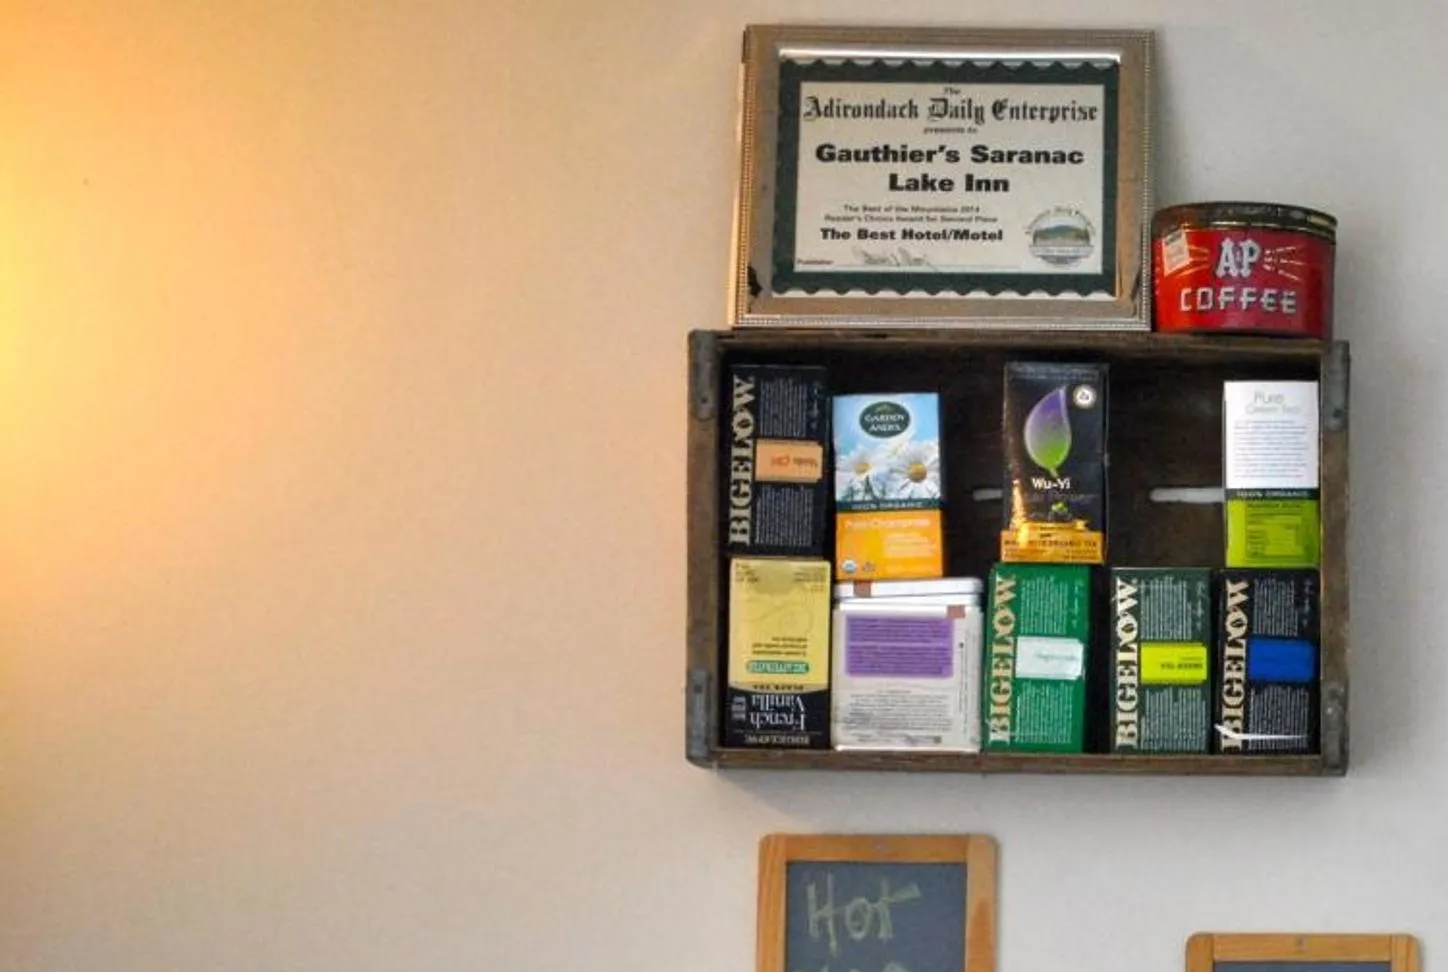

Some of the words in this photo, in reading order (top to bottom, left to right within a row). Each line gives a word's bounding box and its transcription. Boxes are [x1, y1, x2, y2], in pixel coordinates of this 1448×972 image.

[803, 96, 918, 121] Adirondack
[926, 97, 985, 125] Daily
[991, 99, 1098, 124] Enterprise
[815, 144, 960, 164] Gauthier's
[970, 145, 1084, 165] Saranac
[889, 173, 954, 192] Lake
[965, 174, 1010, 192] Inn
[820, 228, 850, 240] The
[857, 229, 895, 241] Best
[900, 229, 1003, 242] Hotel/Motel
[1180, 287, 1297, 315] COFFEE
[729, 374, 756, 546] BIGELOW
[1031, 477, 1072, 490] Wu-Yi
[988, 573, 1017, 746] BIGELOW
[1114, 575, 1139, 749] BIGELOW
[1221, 578, 1249, 752] BIGELOW
[751, 695, 806, 713] Vanilla
[749, 712, 806, 731] French
